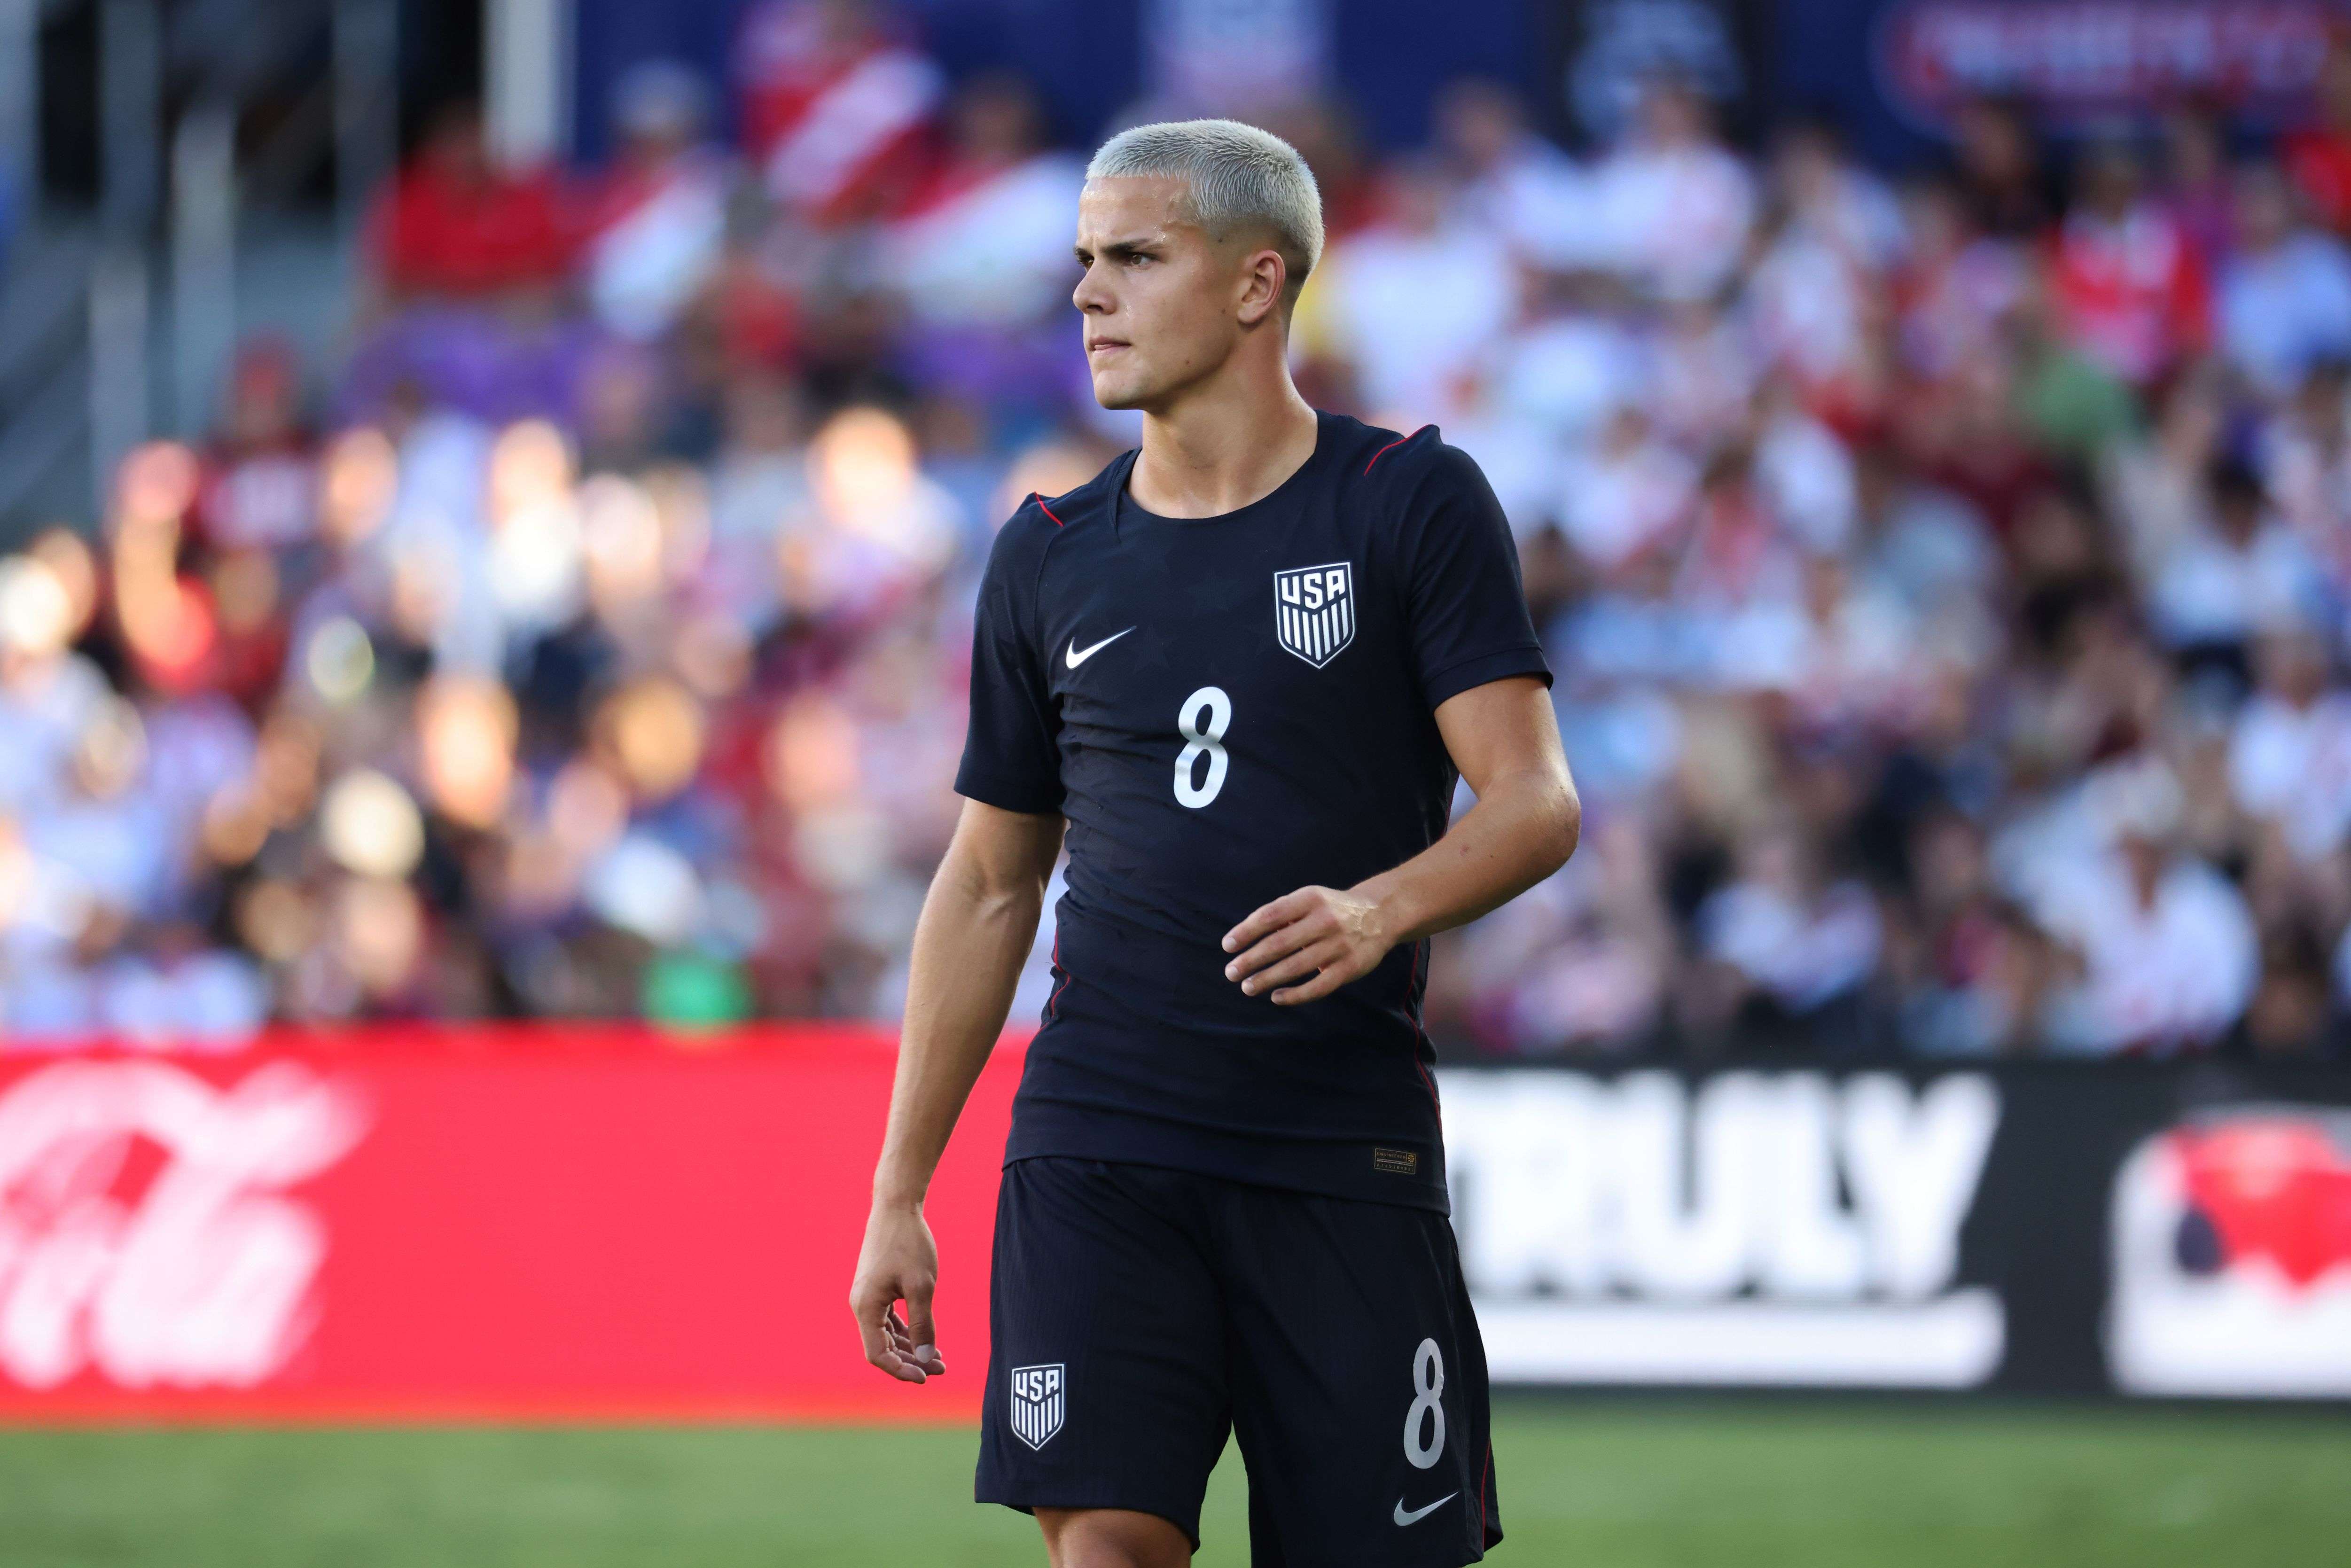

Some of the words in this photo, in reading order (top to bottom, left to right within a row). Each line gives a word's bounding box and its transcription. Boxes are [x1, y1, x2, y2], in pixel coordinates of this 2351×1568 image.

[1281, 569, 1345, 610] USA
[1173, 686, 1231, 809] 8
[1015, 1369, 1059, 1402] USA
[1404, 1338, 1445, 1469] 8
